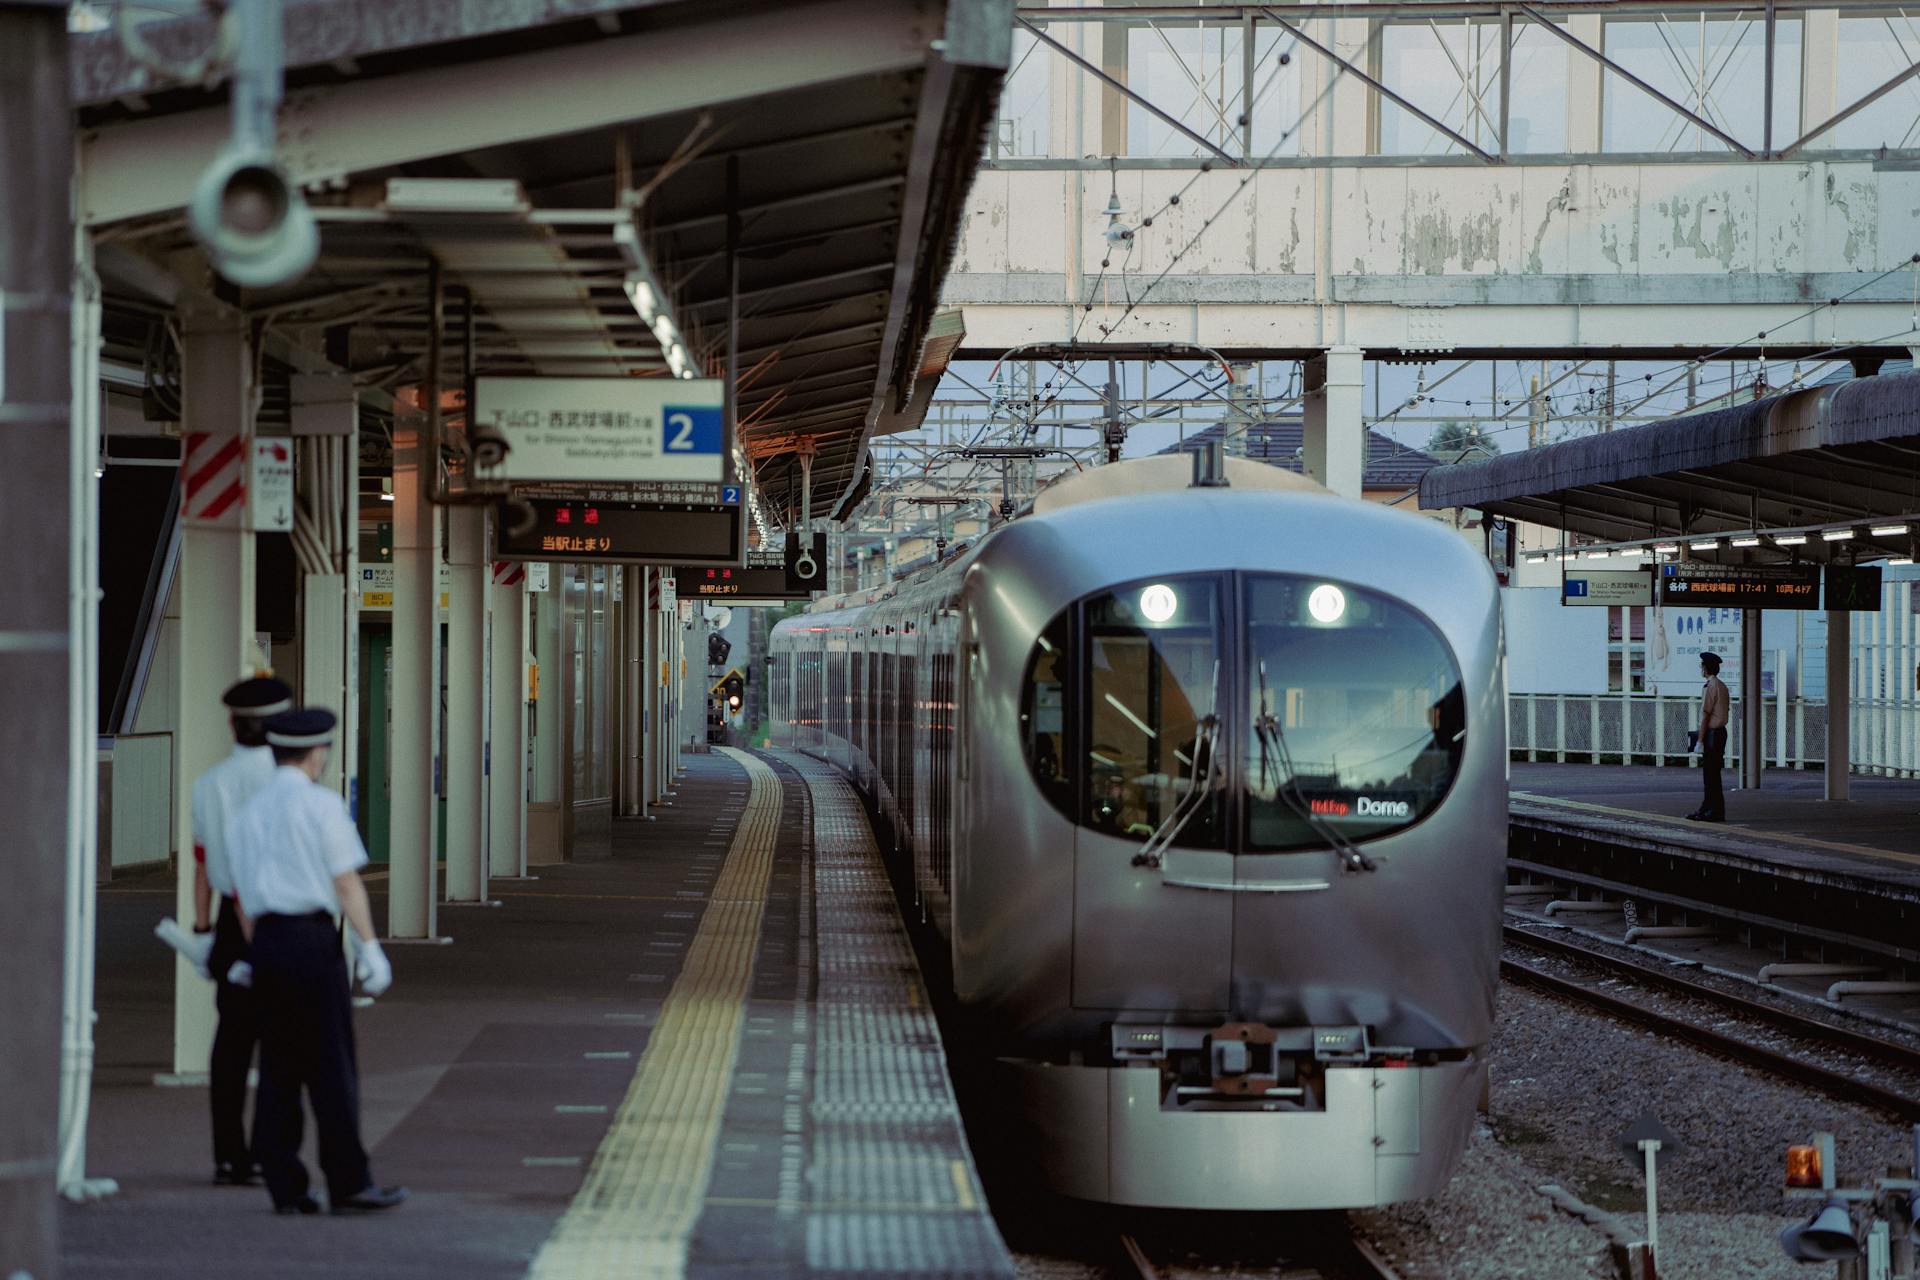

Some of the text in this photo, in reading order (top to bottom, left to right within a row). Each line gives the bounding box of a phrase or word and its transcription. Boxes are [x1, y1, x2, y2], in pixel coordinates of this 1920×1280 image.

[667, 413, 694, 450] 2
[727, 488, 737, 502] 2
[542, 536, 611, 551] 当駅止まり
[364, 570, 372, 579] 4
[1666, 567, 1673, 575] 1
[1577, 582, 1584, 595] 1
[1669, 582, 1688, 592] 各停
[1691, 583, 1736, 593] 西武球場前
[1740, 584, 1767, 592] 17:41
[1357, 796, 1409, 816] Dome
